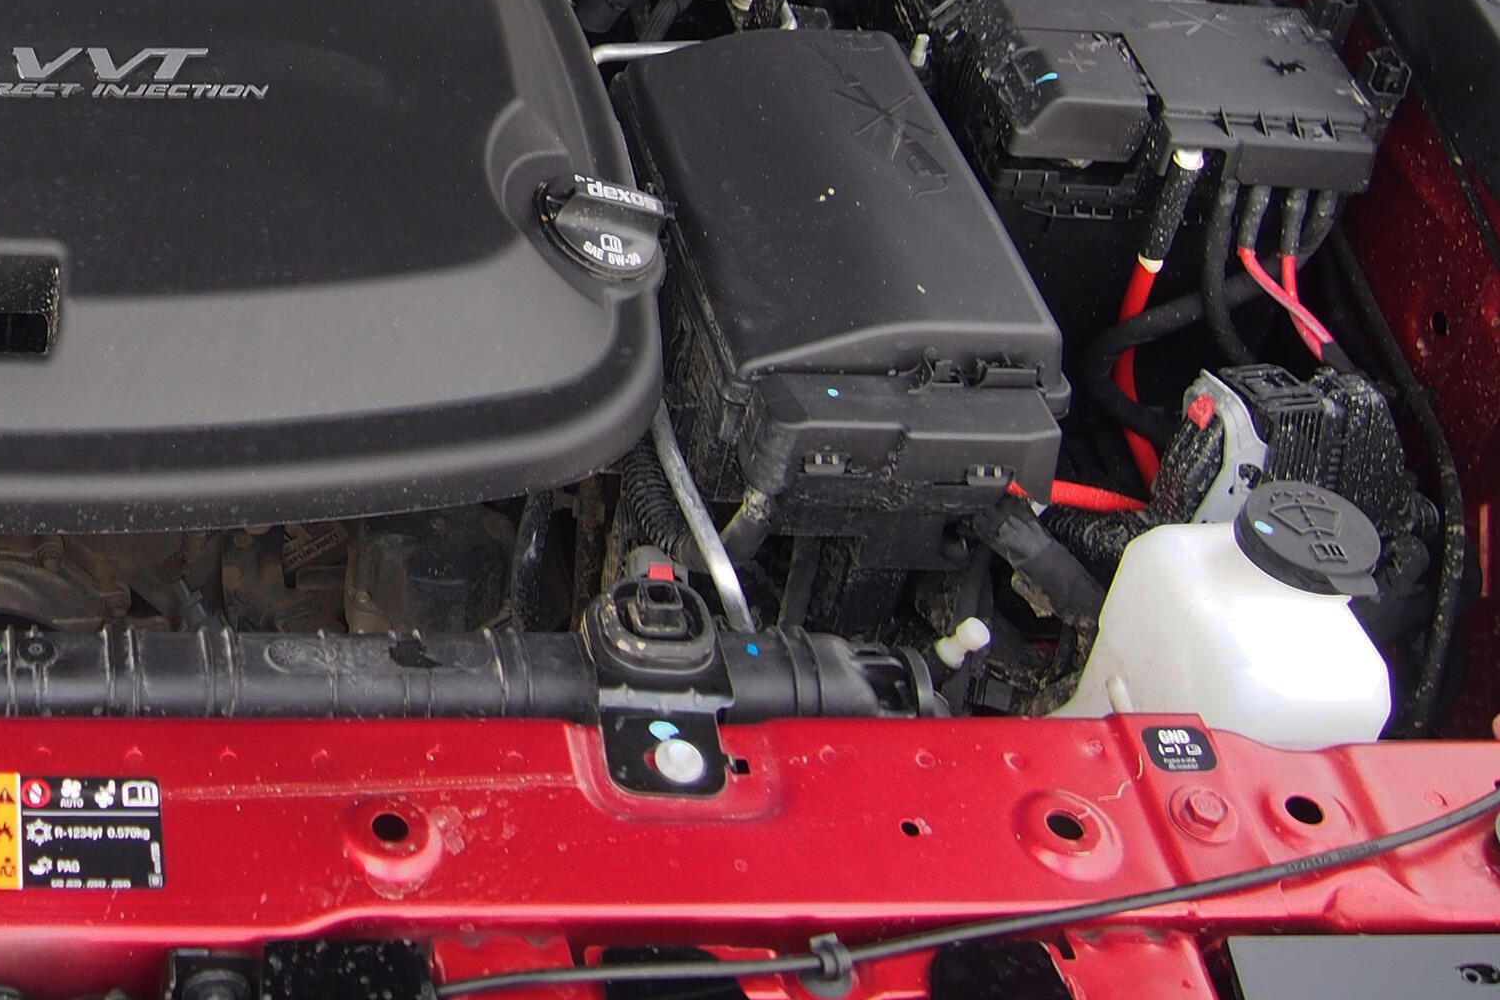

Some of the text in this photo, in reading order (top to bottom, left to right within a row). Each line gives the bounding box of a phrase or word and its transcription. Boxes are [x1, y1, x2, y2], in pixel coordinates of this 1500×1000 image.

[12, 47, 209, 81] VVT
[91, 83, 270, 99] INJECTION
[587, 181, 658, 211] dexos
[583, 241, 605, 261] SAE
[1158, 729, 1191, 745] GND
[60, 797, 84, 809] AUTO
